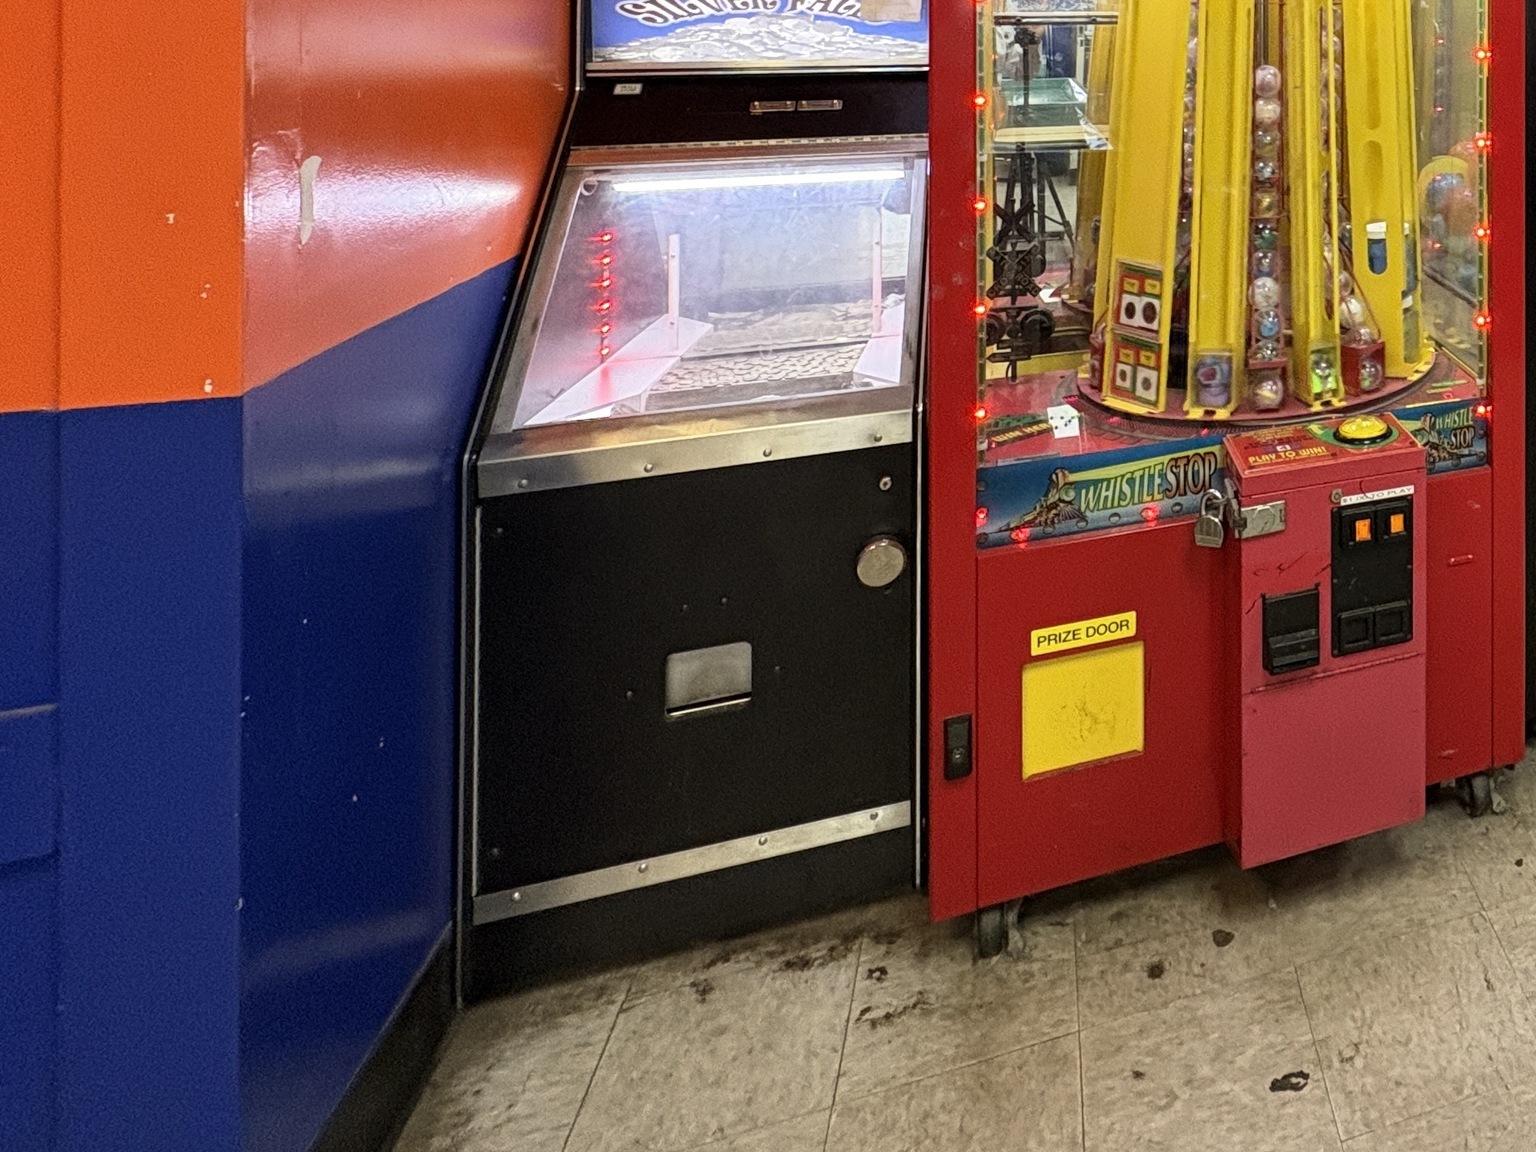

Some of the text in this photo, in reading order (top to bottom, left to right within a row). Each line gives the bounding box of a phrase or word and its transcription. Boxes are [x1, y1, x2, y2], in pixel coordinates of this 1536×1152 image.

[1450, 426, 1475, 450] STOP
[1248, 445, 1327, 464] PLAY TO WIN!
[1387, 487, 1412, 497] PLAY
[1036, 619, 1131, 648] PRIZE DOOR
